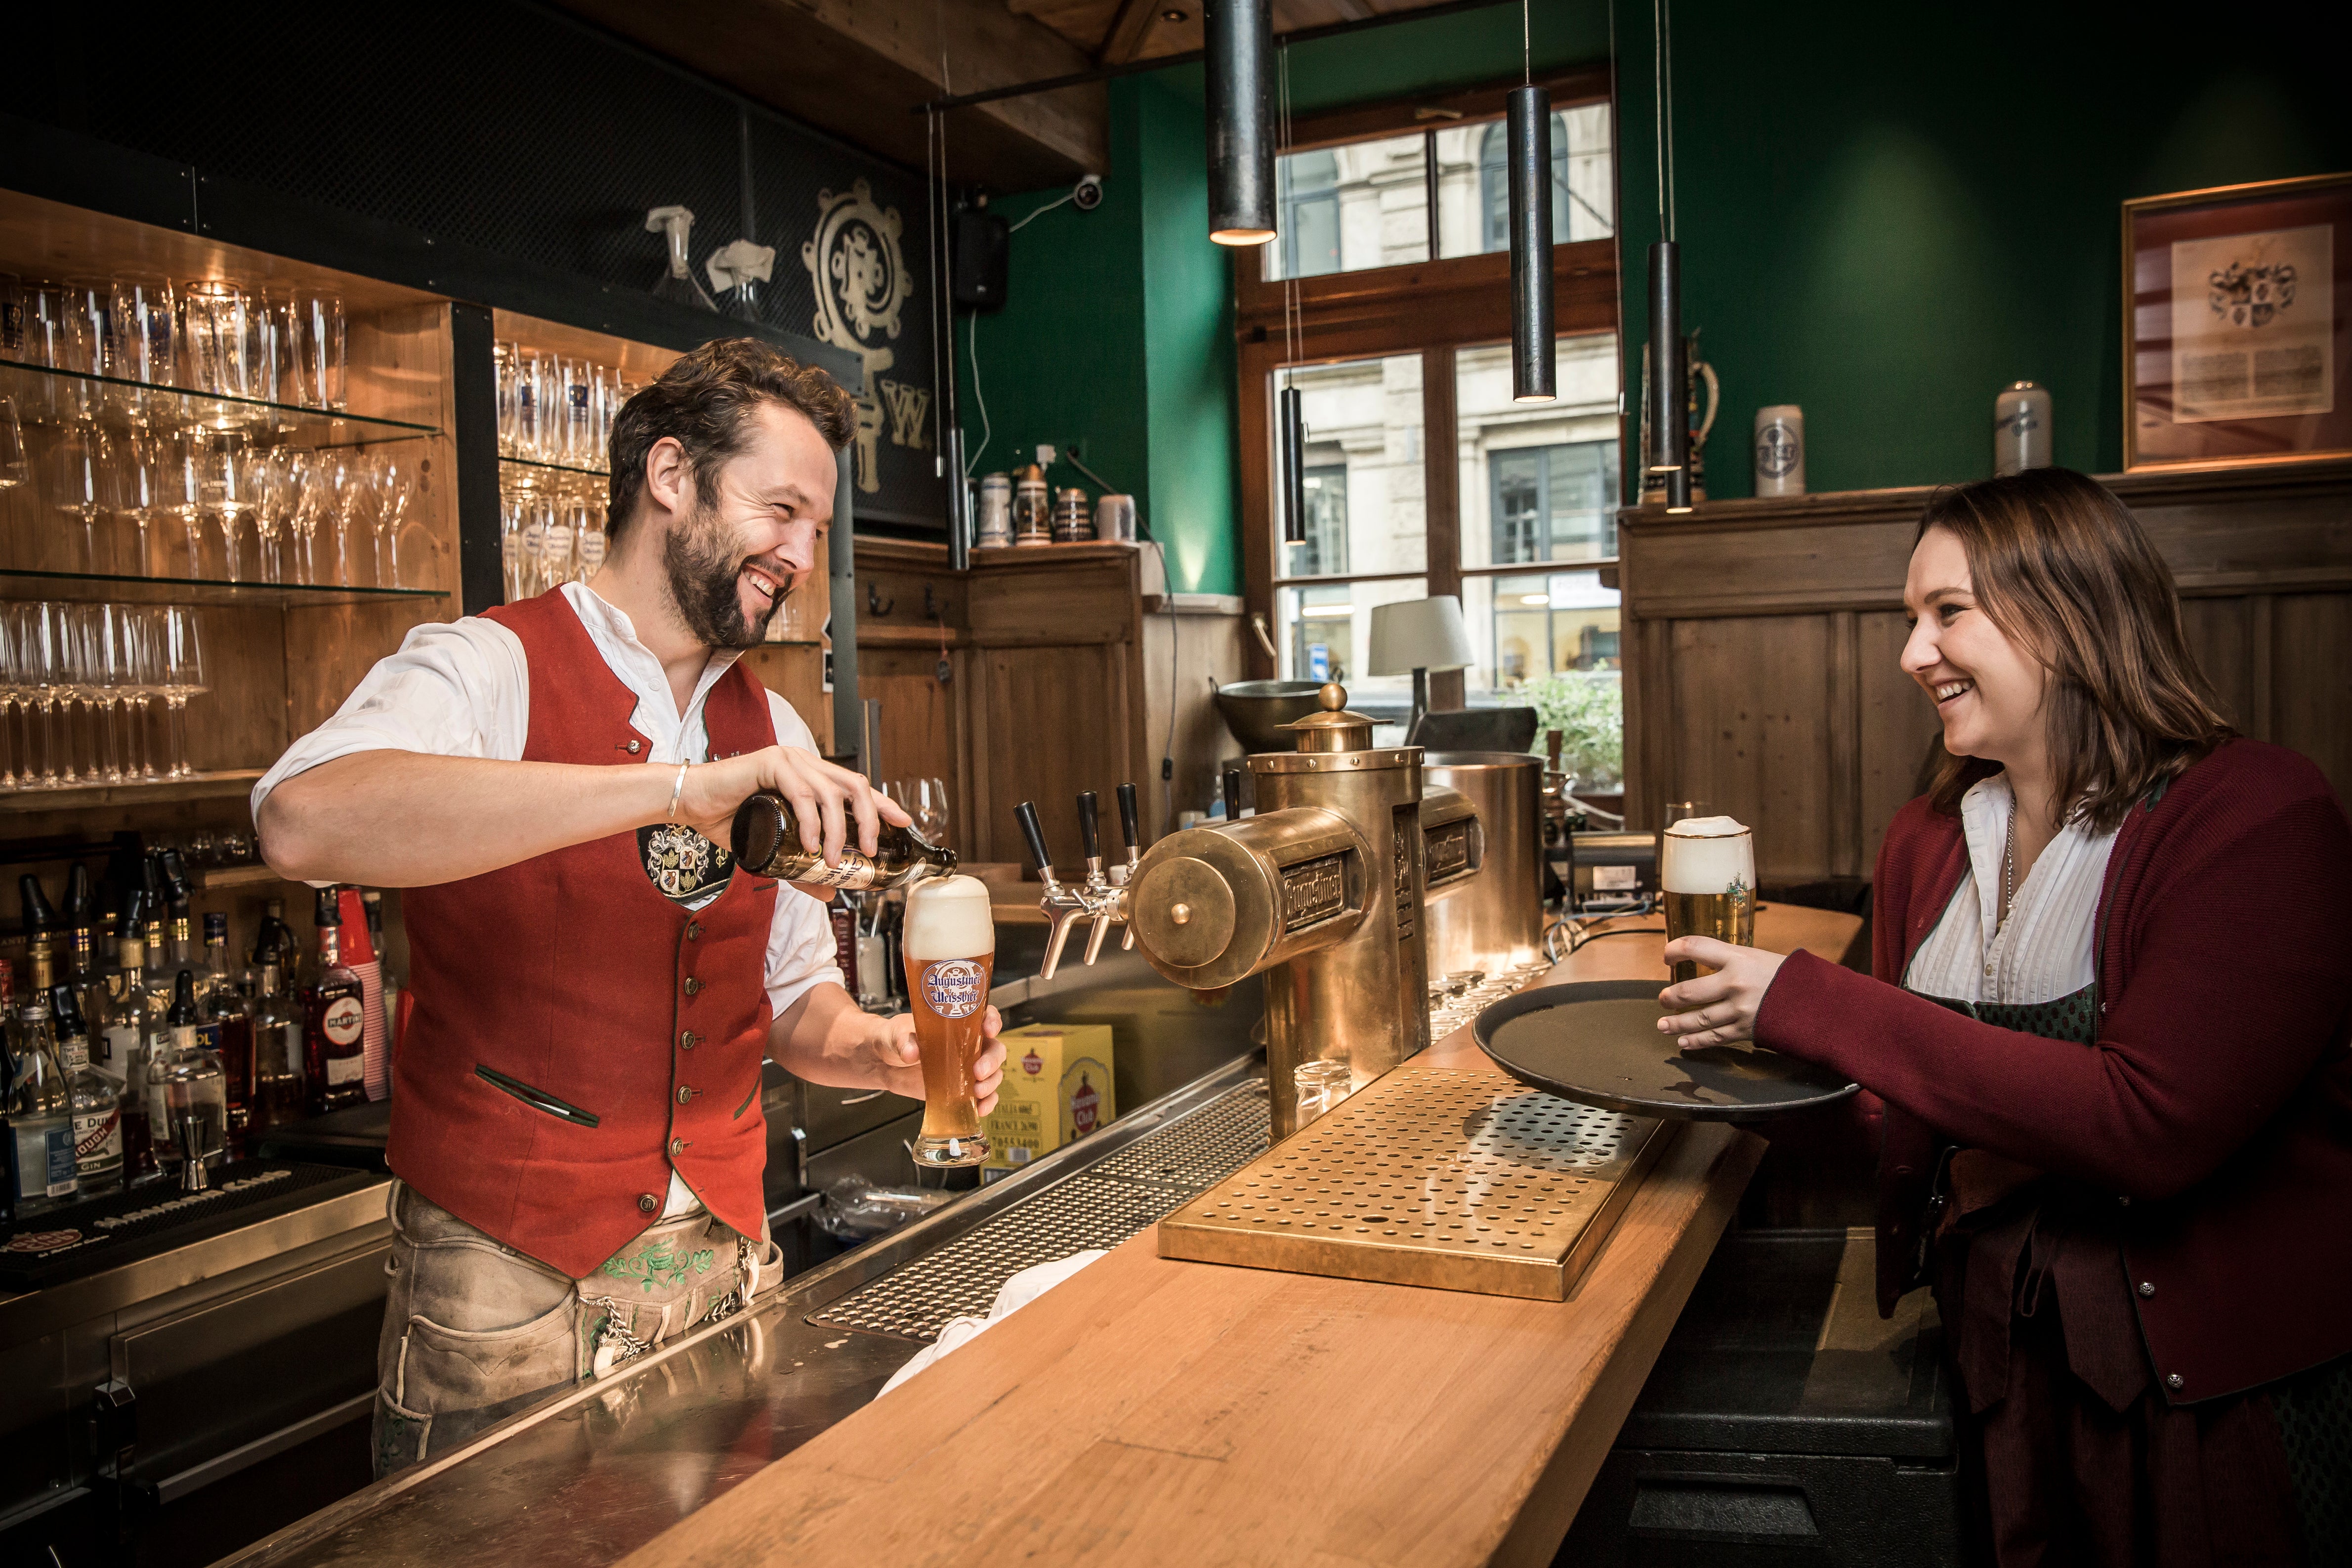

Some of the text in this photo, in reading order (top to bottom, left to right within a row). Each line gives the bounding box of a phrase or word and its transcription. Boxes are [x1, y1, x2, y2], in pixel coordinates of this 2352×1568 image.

[927, 972, 982, 989] Augustiner
[930, 989, 978, 1004] Weissbier
[81, 1162, 101, 1170] GIN
